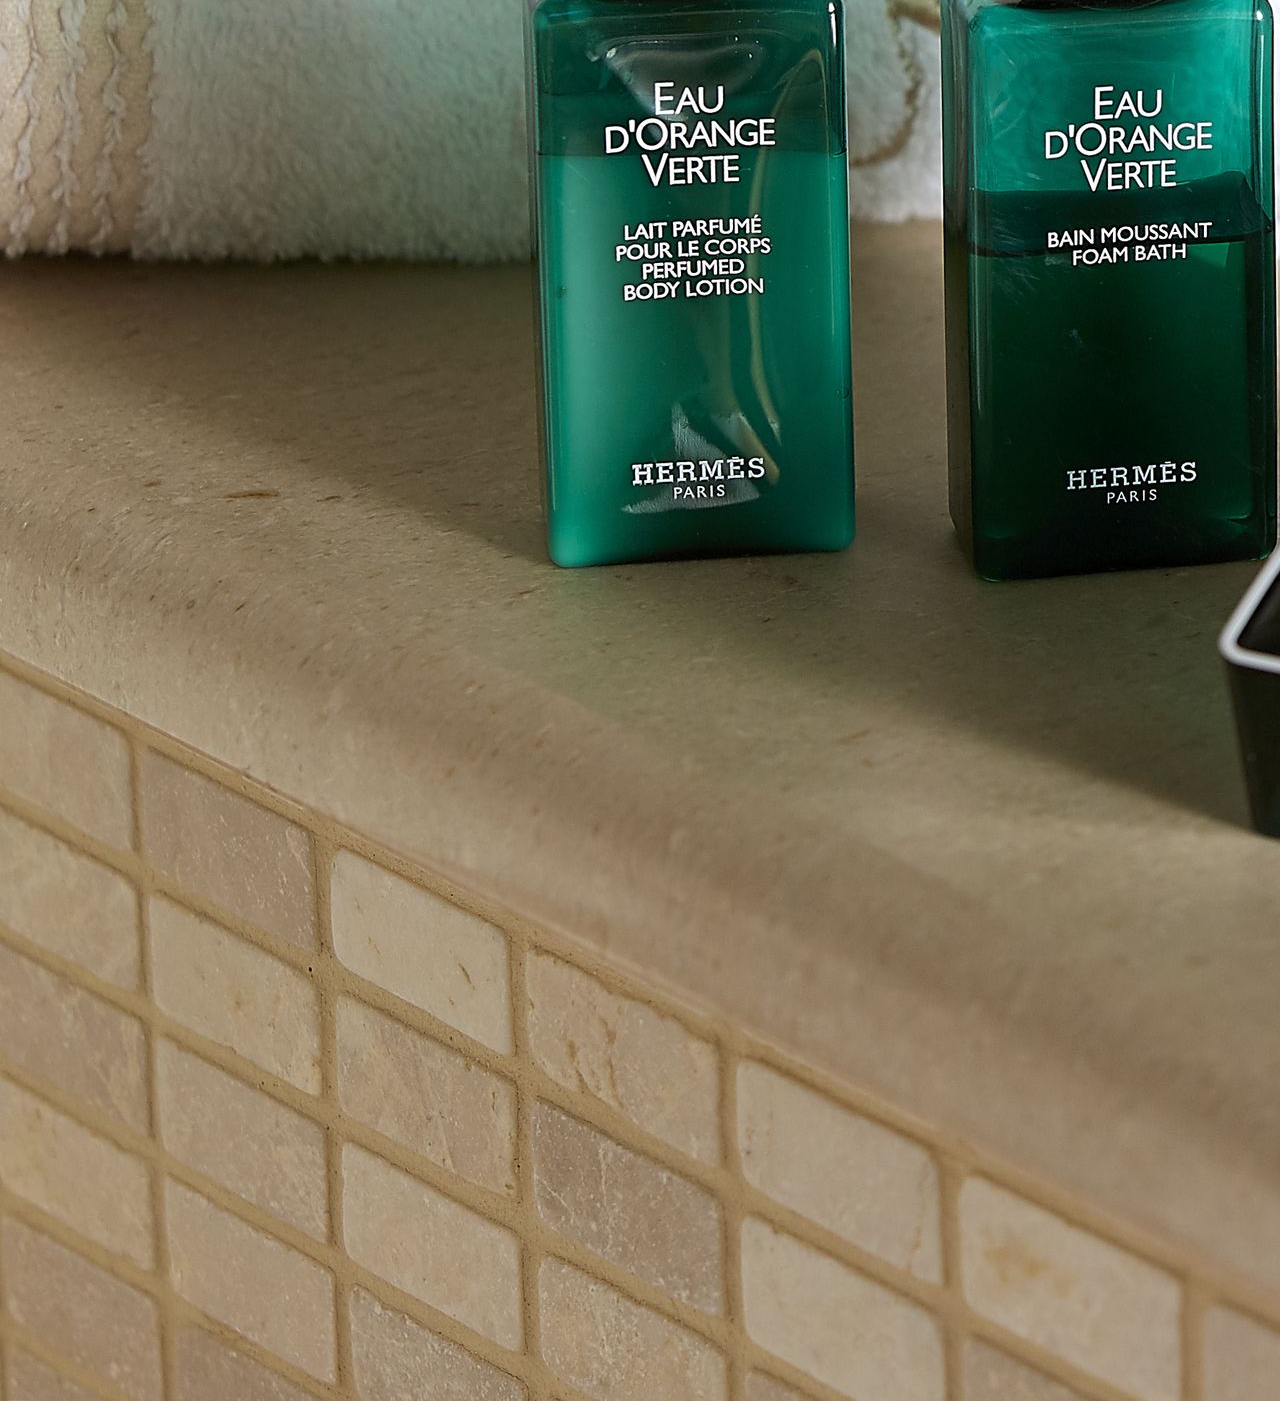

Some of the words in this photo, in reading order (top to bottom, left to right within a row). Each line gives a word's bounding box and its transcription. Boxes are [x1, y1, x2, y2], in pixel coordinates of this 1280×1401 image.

[654, 81, 724, 116] EAU
[1094, 85, 1162, 120] EAU
[605, 117, 776, 154] D'ORANGE
[1045, 122, 1213, 159] D'ORANGE
[641, 152, 740, 187] VERTE
[1080, 158, 1177, 192] VERTE
[624, 221, 668, 241] LAIT
[672, 213, 762, 238] PARFUMÉ
[1047, 228, 1095, 248] BAIN
[1100, 221, 1213, 244] MOUSSANT
[615, 242, 673, 262] POUR
[677, 239, 700, 258] LE
[704, 237, 771, 255] CORPS
[1072, 246, 1129, 266] FOAM
[1135, 243, 1186, 261] BATH
[642, 258, 745, 281] PERFUMED
[623, 281, 681, 301] BODY
[685, 277, 764, 298] LOTION
[673, 484, 725, 500] PARIS
[1107, 488, 1157, 504] PARIS
